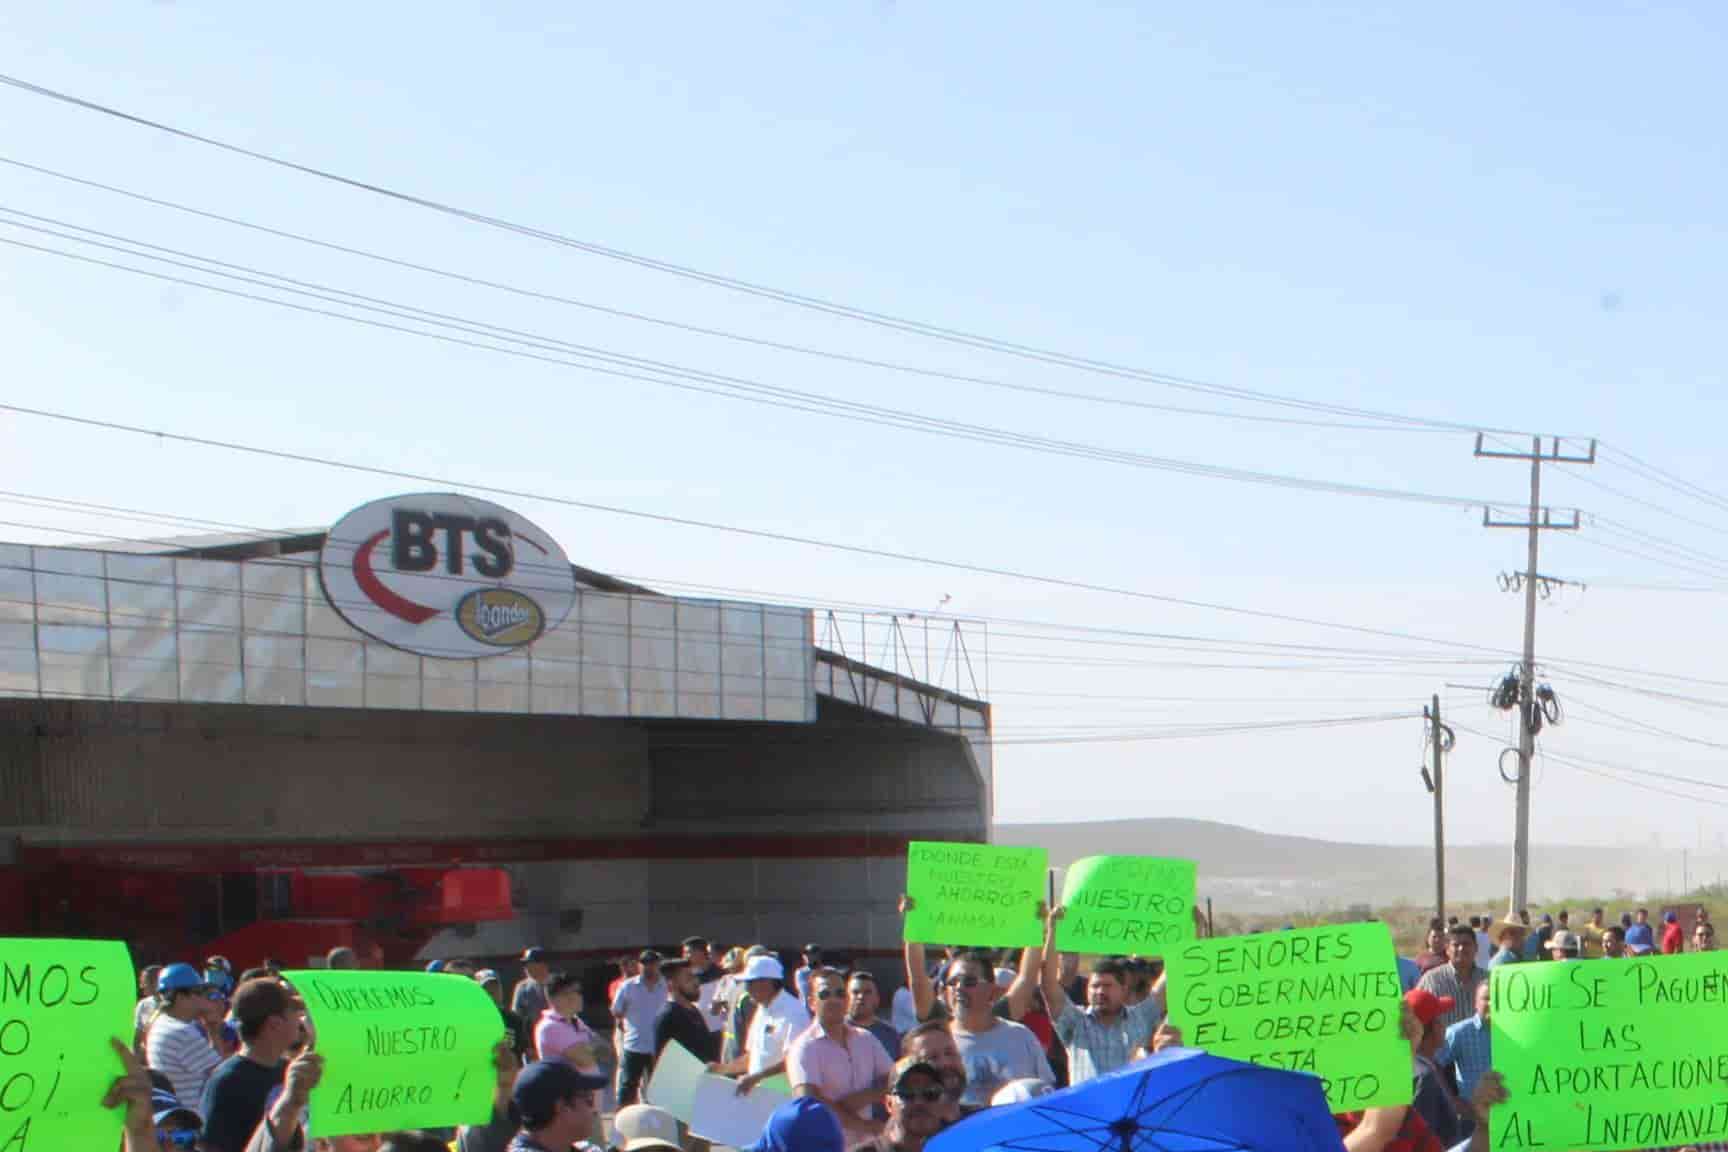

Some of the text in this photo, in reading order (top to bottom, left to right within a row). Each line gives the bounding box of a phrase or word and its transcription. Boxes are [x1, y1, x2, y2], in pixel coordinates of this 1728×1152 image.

[391, 510, 515, 579] BTS
[1071, 916, 1183, 944] AHORRO
[1183, 933, 1353, 978] SEÑORES
[312, 979, 435, 1012] QUEREMOS
[1183, 970, 1400, 1017] GOBERNANTES
[1567, 965, 1608, 1010] SE
[366, 1025, 458, 1058] NUESTRO
[1194, 1008, 1387, 1046] EL OBRERO
[1579, 1020, 1642, 1052] LAS
[335, 1083, 434, 1116] AHORRO
[1499, 1111, 1546, 1149] AL
